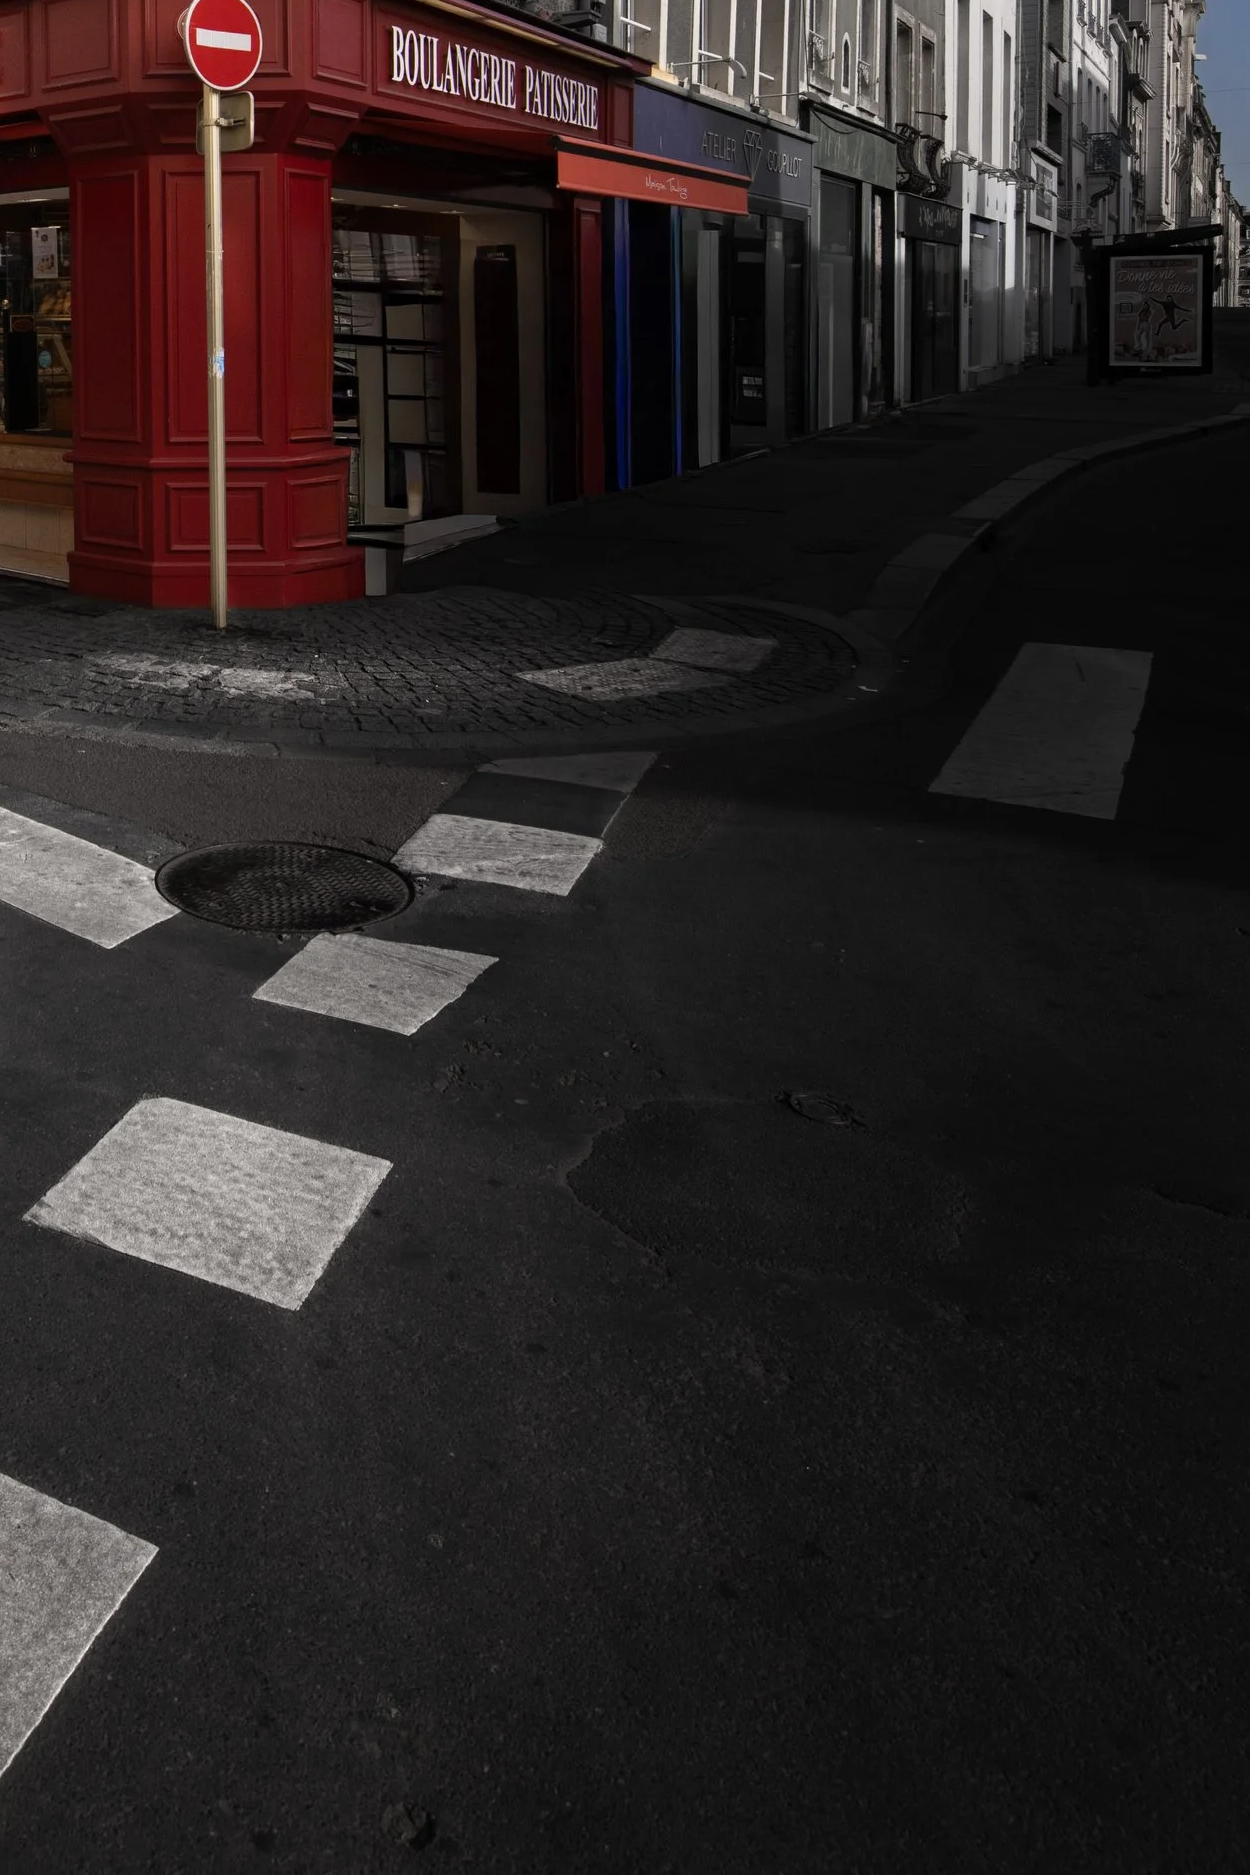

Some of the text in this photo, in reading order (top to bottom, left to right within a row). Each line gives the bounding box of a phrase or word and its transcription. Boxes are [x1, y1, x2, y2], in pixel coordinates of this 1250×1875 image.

[390, 25, 600, 131] BOULANGERIE PATISSERIE
[701, 130, 737, 163] ATELIER
[1117, 267, 1176, 284] Donne vie
